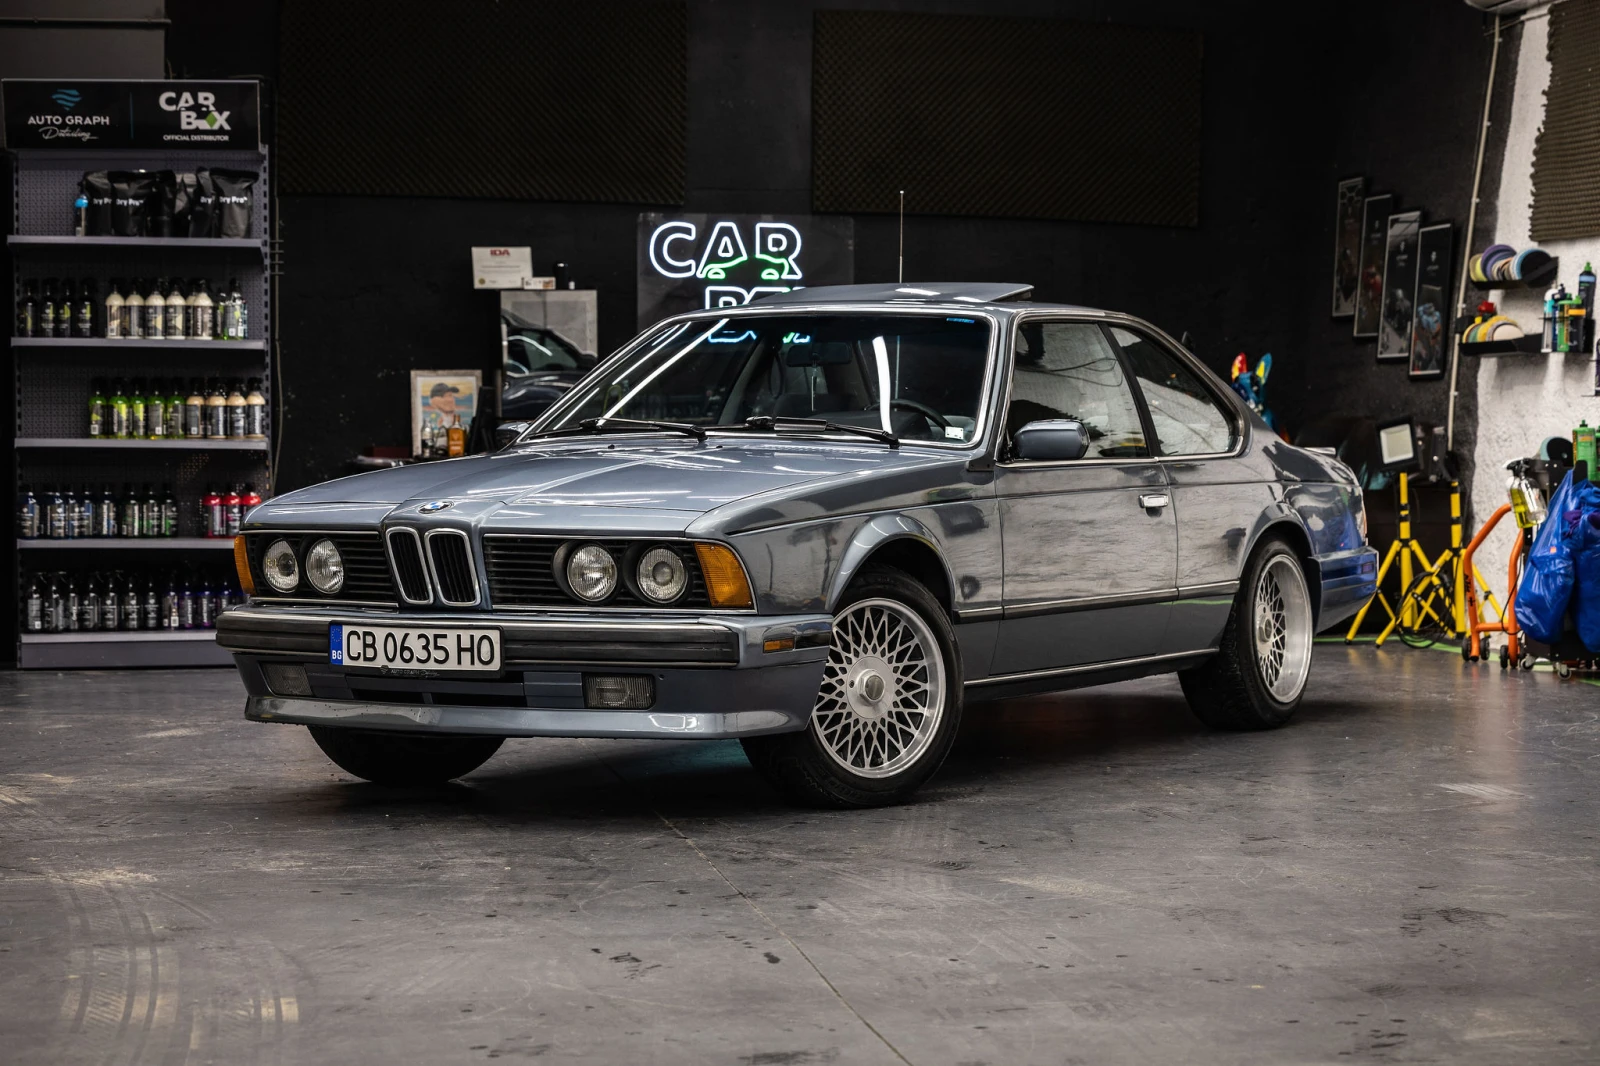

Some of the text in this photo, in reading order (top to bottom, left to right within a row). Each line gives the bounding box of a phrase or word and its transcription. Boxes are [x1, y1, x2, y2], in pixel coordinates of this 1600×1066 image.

[158, 91, 216, 111] CAR
[27, 115, 110, 125] AUTO GRAPH
[649, 221, 802, 280] CAR
[332, 650, 342, 660] BG
[346, 630, 495, 666] CB 0635 HO
